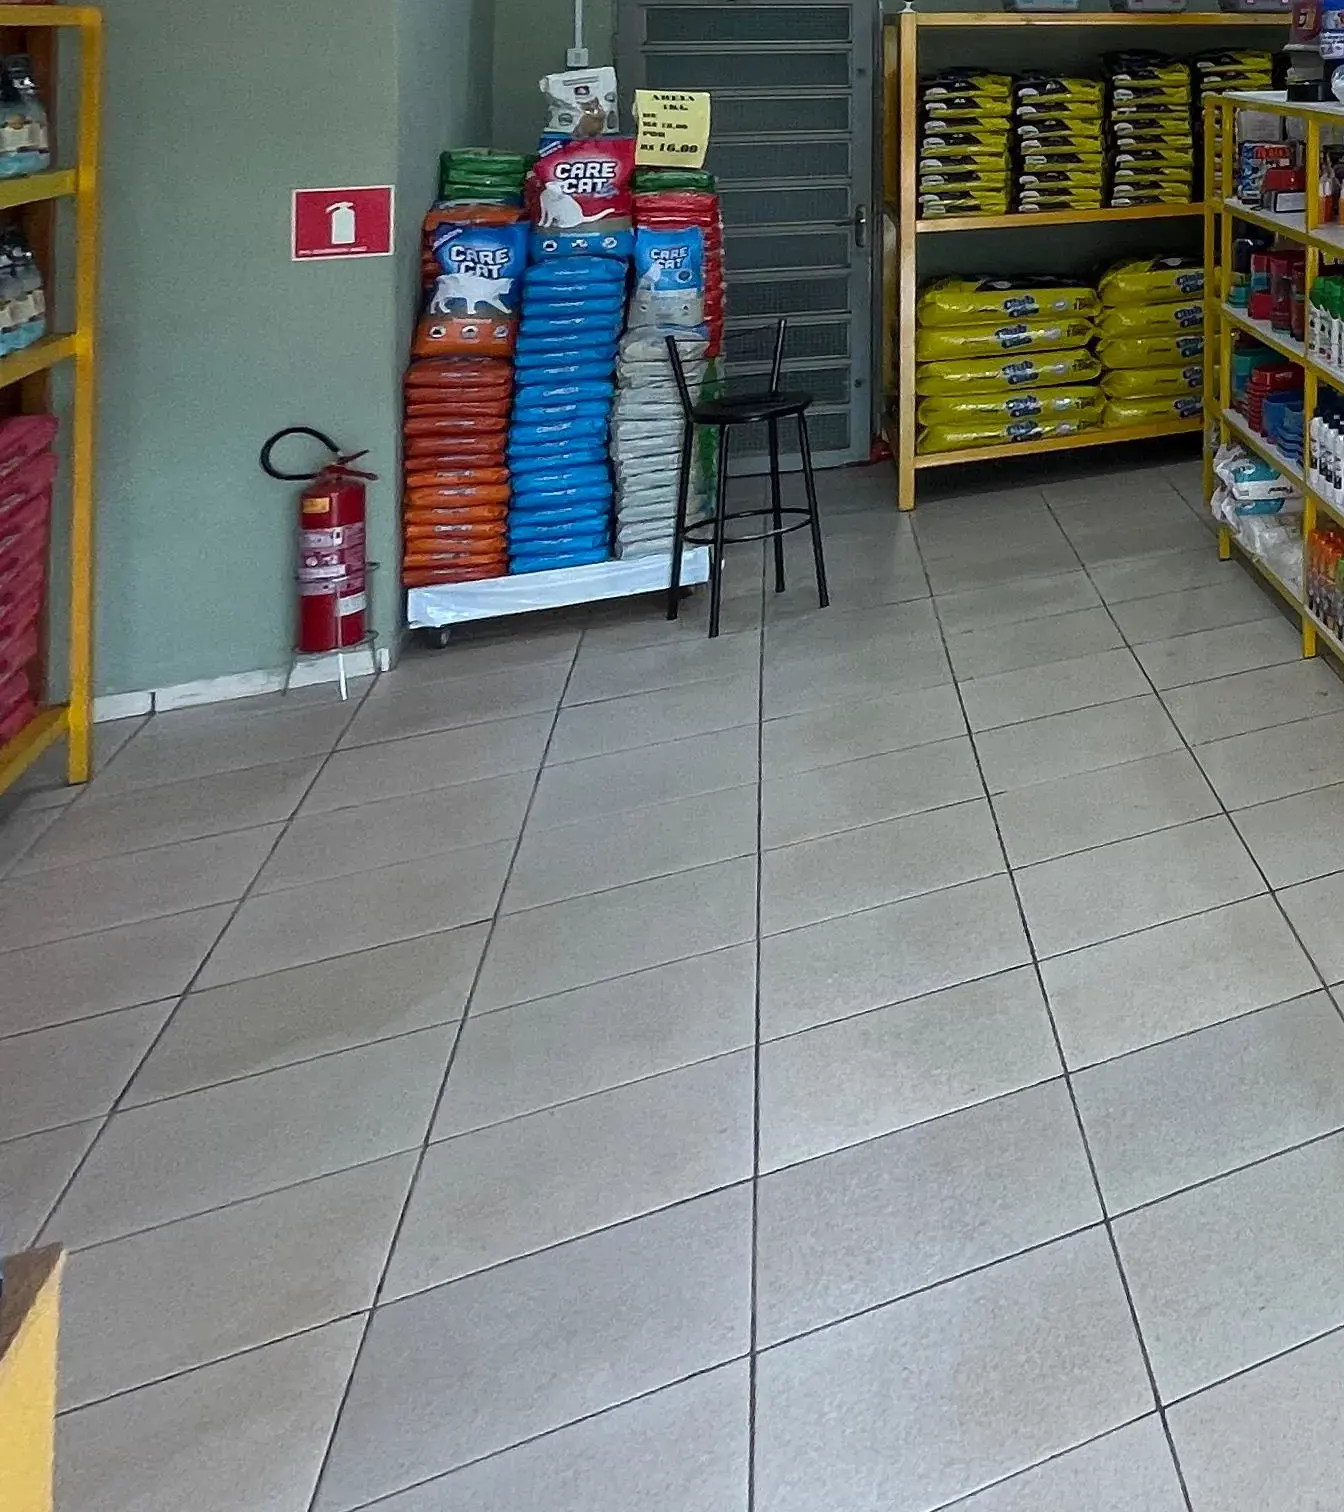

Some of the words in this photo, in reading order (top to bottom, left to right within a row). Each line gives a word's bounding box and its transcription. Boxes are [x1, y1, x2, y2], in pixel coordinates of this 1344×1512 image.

[555, 162, 617, 179] CARE
[564, 179, 606, 194] CAT
[451, 246, 509, 264] CARE
[651, 247, 688, 259] CARE
[461, 263, 502, 279] CAT
